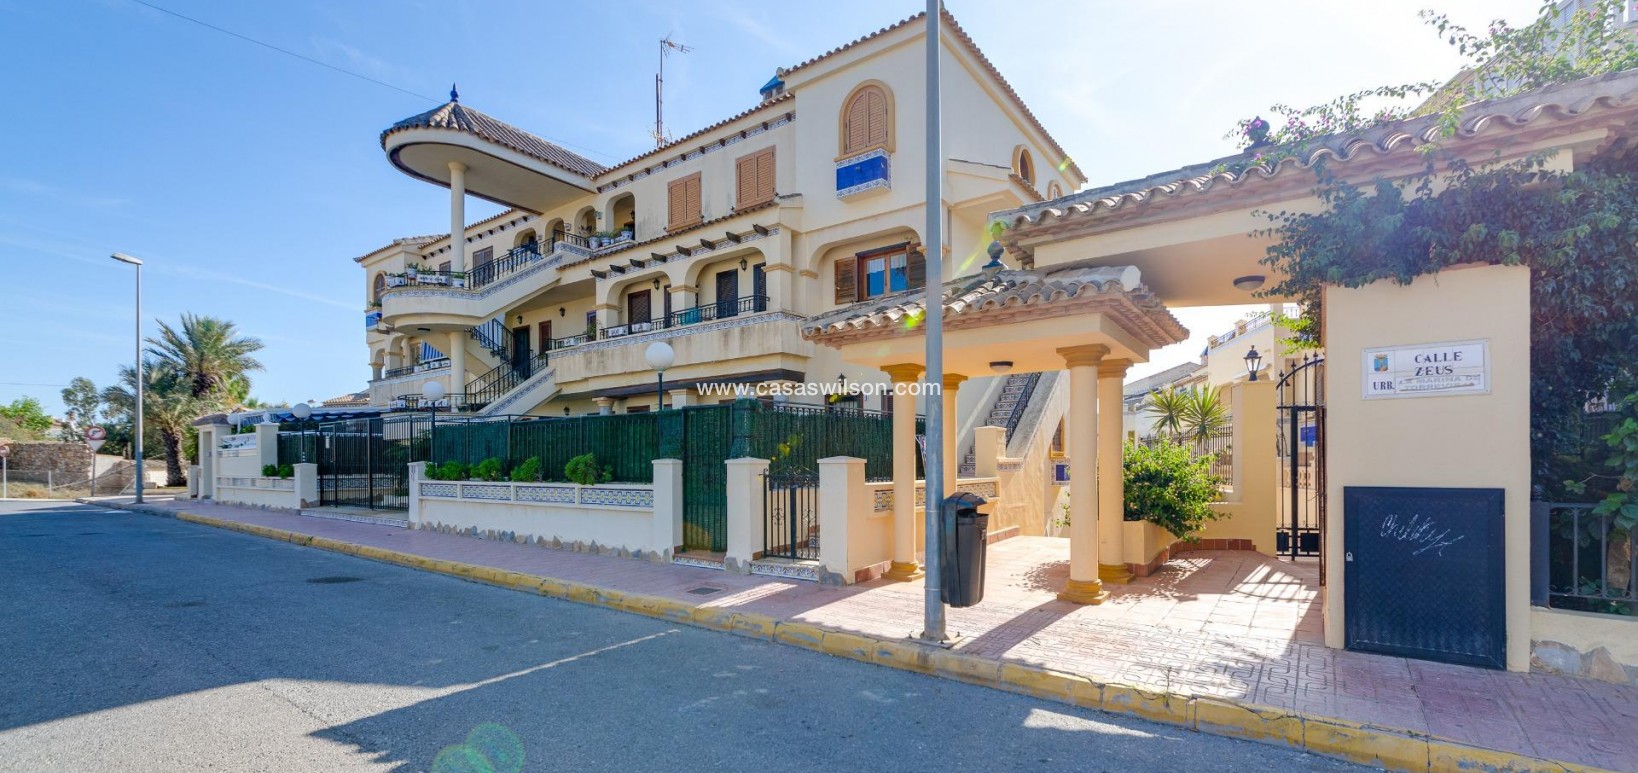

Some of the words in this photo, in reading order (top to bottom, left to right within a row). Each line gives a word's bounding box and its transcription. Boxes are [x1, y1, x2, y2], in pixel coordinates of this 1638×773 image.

[1414, 351, 1463, 364] CALLE
[1415, 365, 1454, 377] ZEUS
[1373, 381, 1395, 391] URB.
